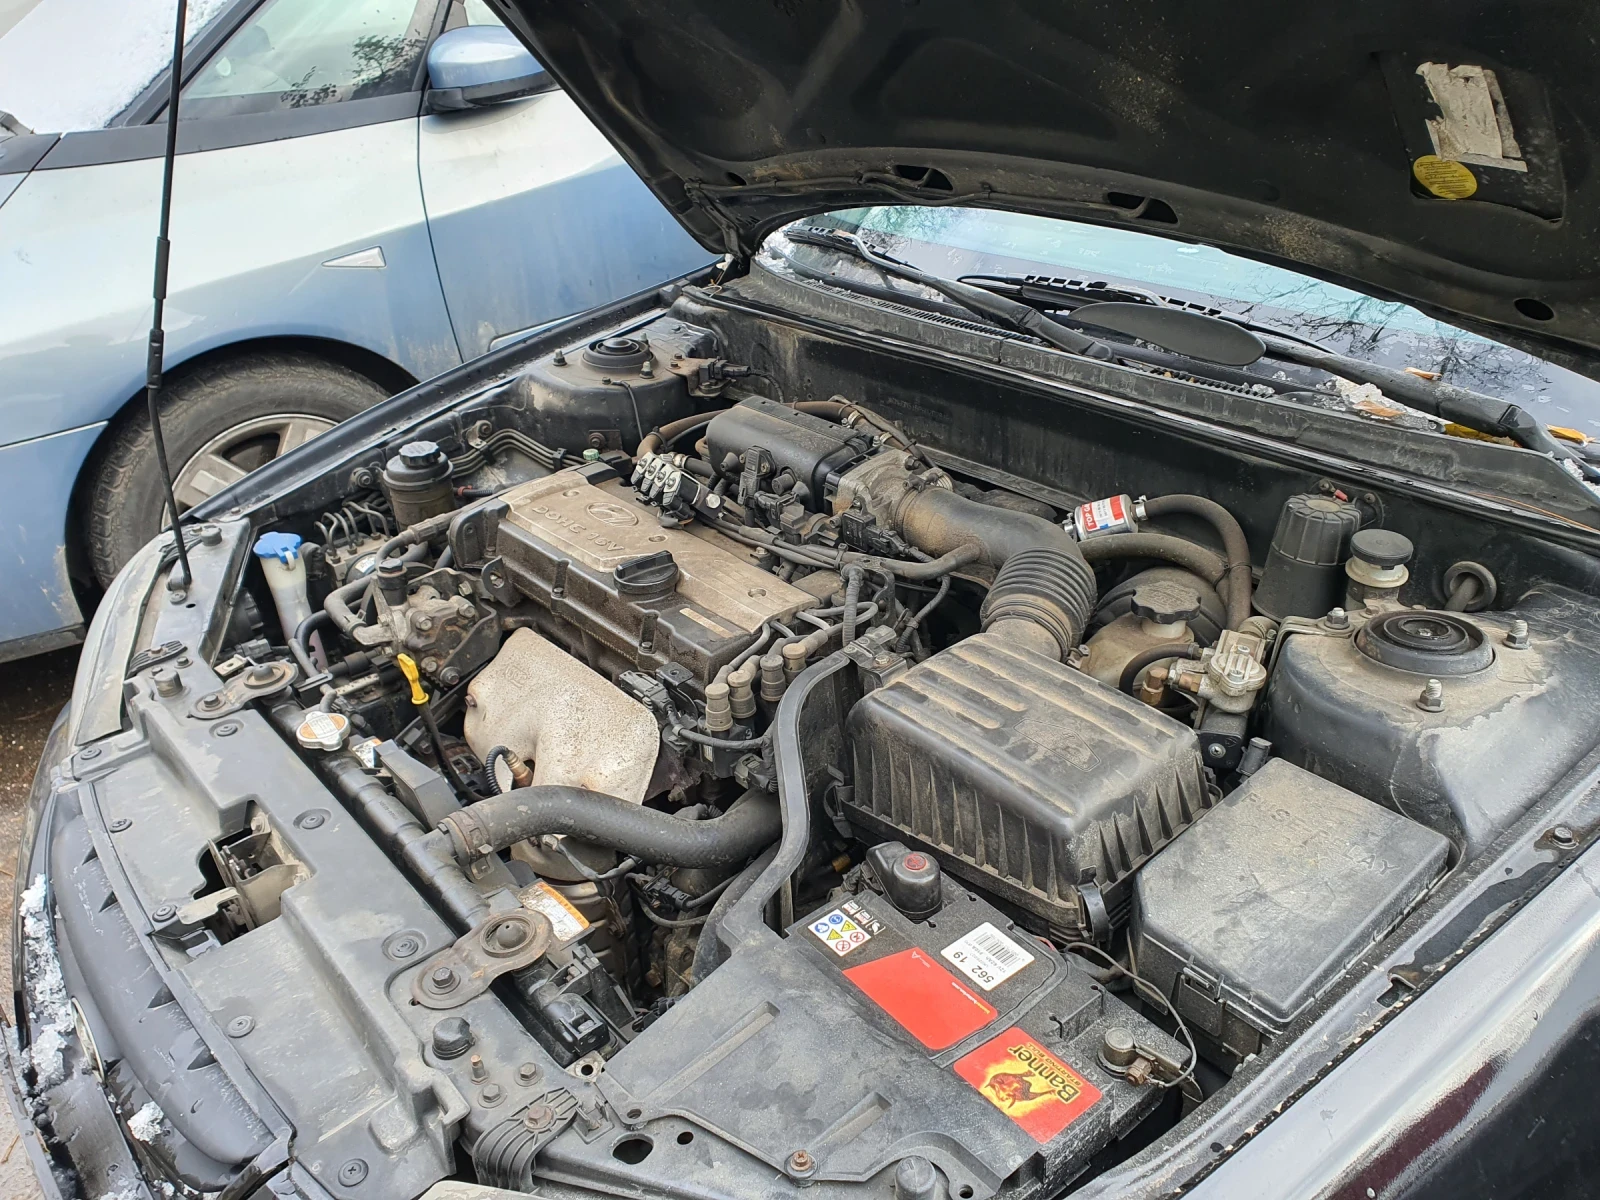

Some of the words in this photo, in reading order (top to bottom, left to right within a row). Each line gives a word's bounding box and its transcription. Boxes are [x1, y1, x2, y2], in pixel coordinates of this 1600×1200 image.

[532, 505, 587, 534] DOHC
[587, 532, 625, 551] 16V
[1085, 513, 1094, 526] TOP
[952, 950, 968, 964] 19
[971, 965, 994, 984] 562
[1026, 1042, 1045, 1057] BULL
[1008, 1043, 1079, 1102] Banner
[1045, 1057, 1082, 1086] STARTING
